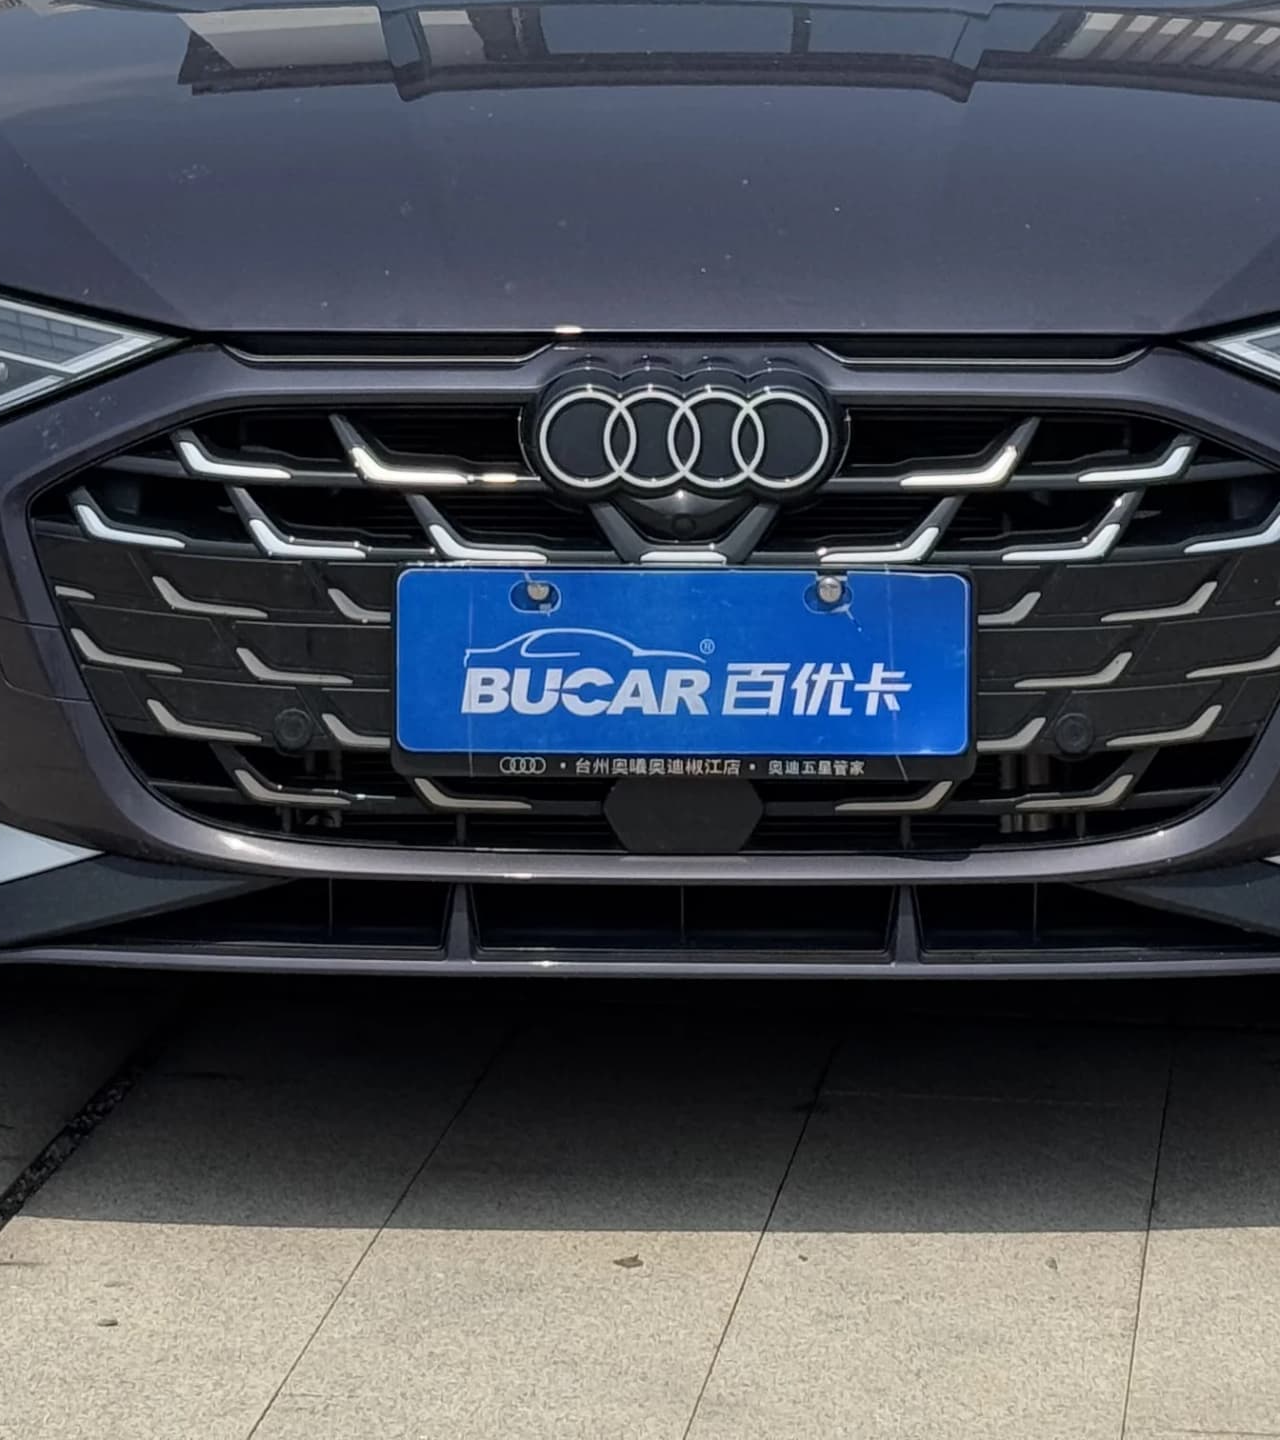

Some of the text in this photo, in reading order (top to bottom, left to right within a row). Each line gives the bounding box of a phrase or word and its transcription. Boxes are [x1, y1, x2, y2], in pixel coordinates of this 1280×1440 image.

[461, 662, 913, 717] BUCAR 百优卡
[768, 759, 865, 777] 奥迪五星管家
